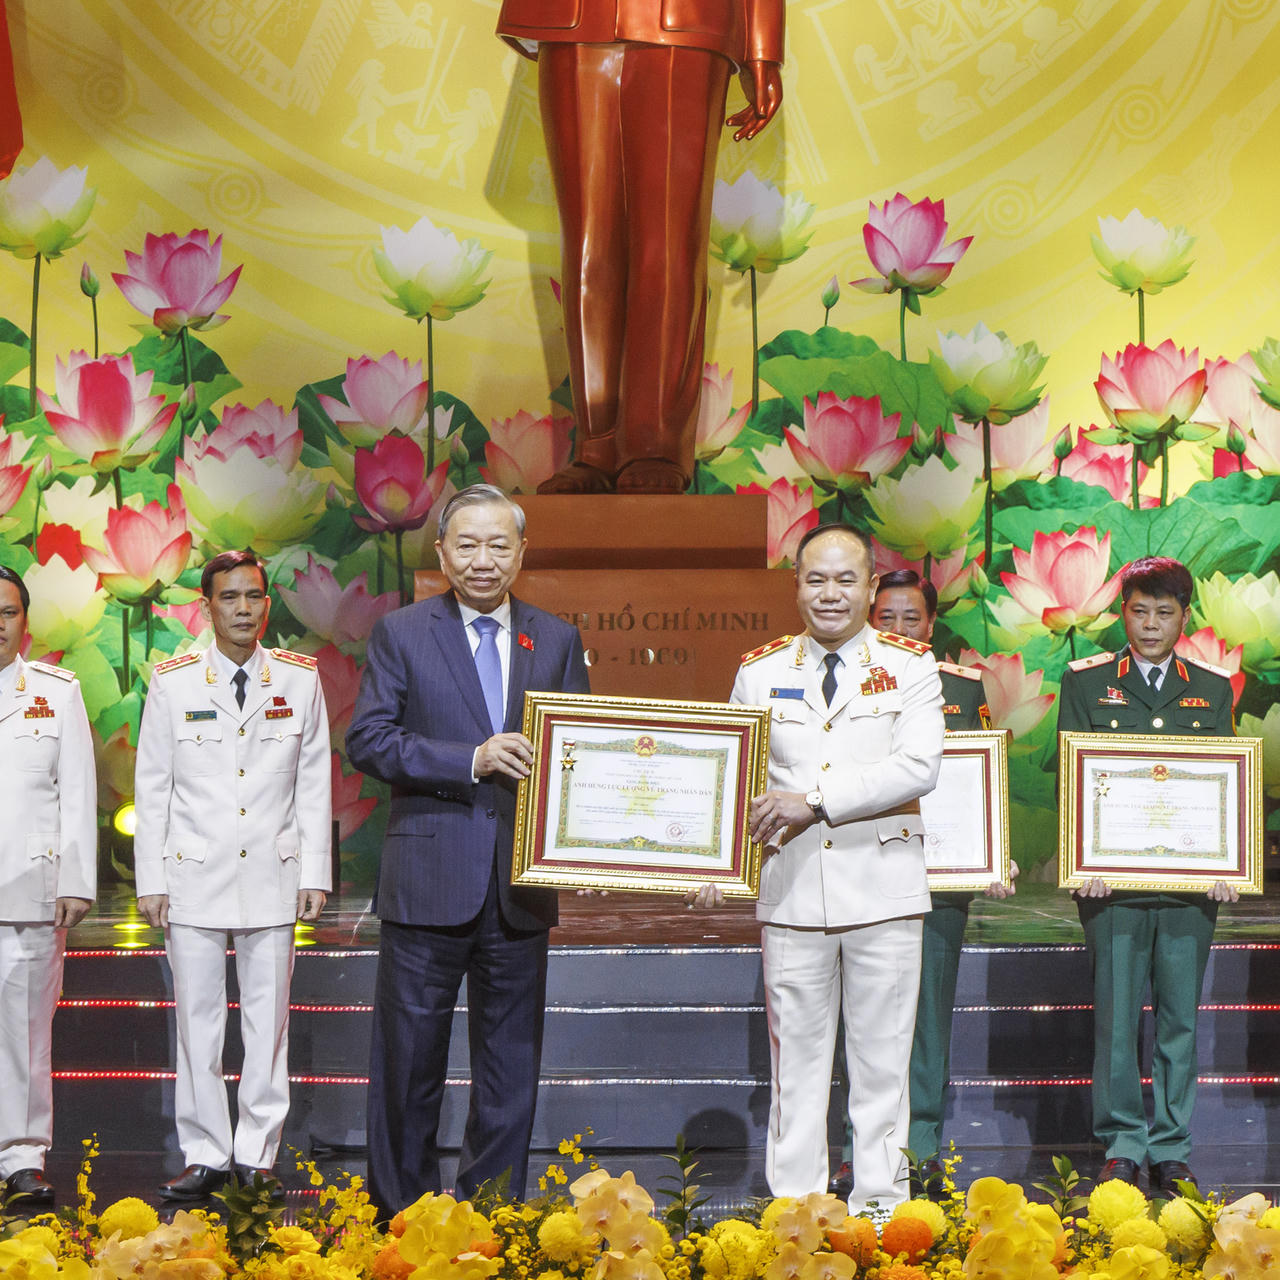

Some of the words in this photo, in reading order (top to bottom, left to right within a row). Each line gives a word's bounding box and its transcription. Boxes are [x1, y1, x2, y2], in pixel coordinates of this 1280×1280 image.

[597, 603, 636, 631] HỒ
[642, 607, 690, 631] CHÍ
[695, 612, 770, 631] MINH
